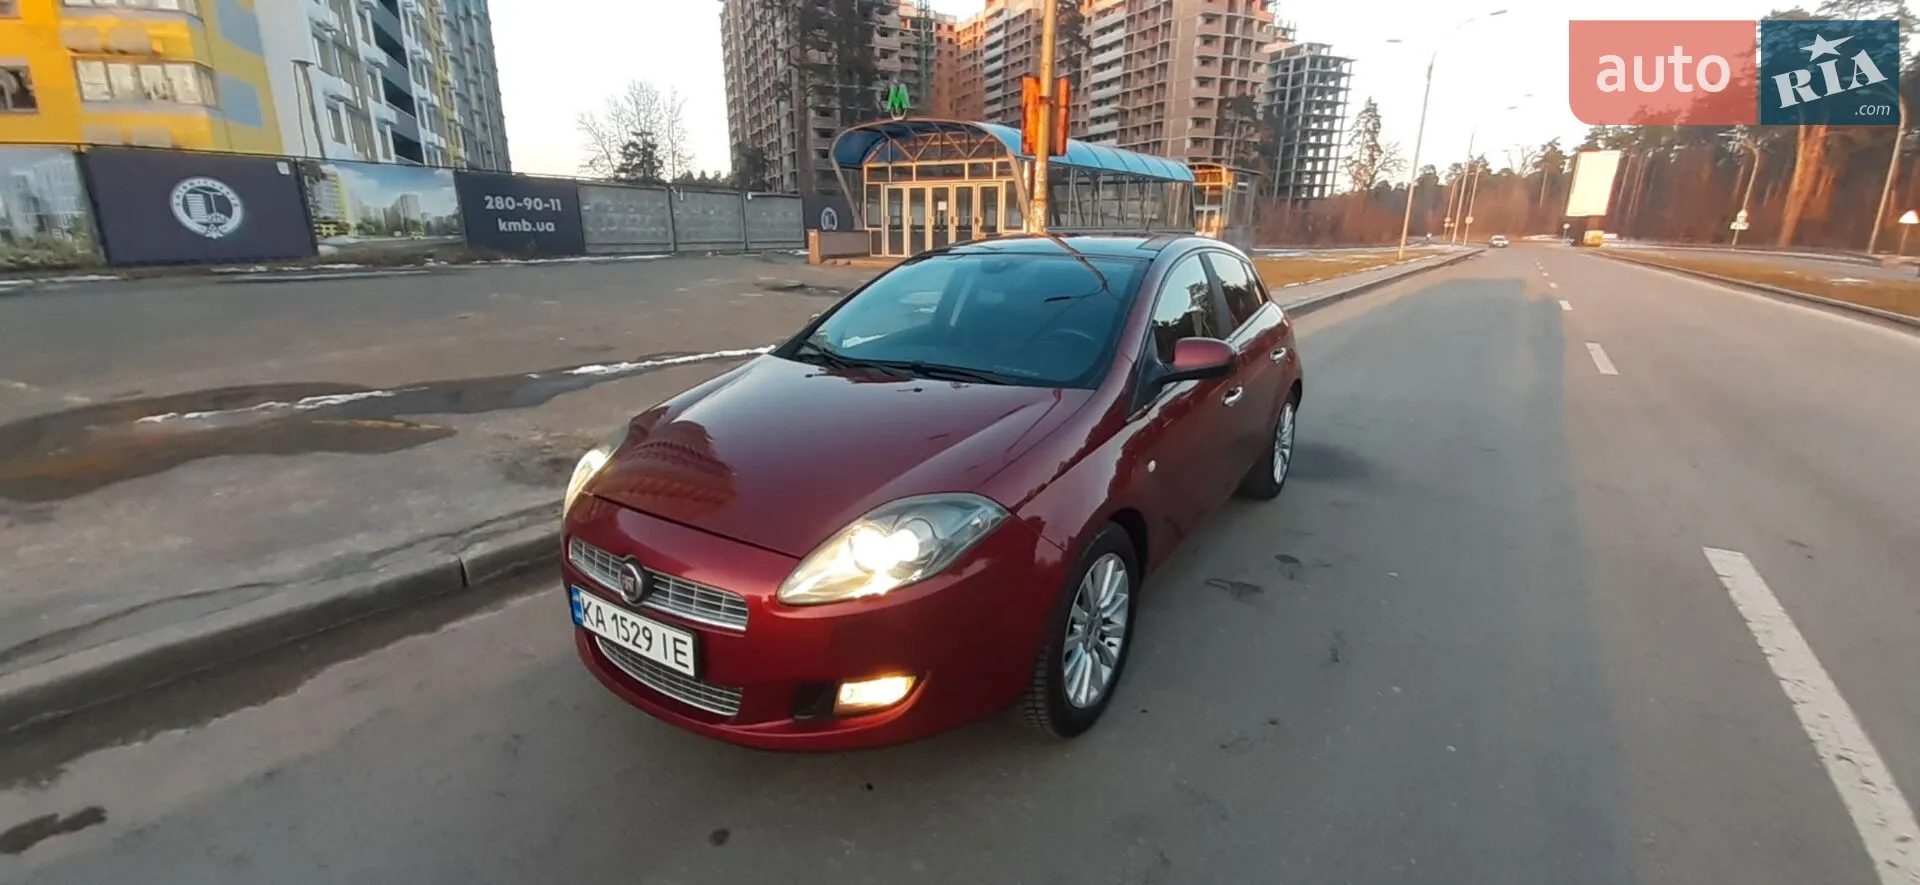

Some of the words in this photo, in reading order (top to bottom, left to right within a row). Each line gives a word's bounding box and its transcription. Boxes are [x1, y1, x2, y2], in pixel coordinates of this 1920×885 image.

[484, 195, 562, 212] 280-90-11
[498, 217, 556, 232] kmb.ua
[581, 597, 607, 632] KA
[611, 612, 653, 652] 1529
[662, 632, 690, 670] IE
